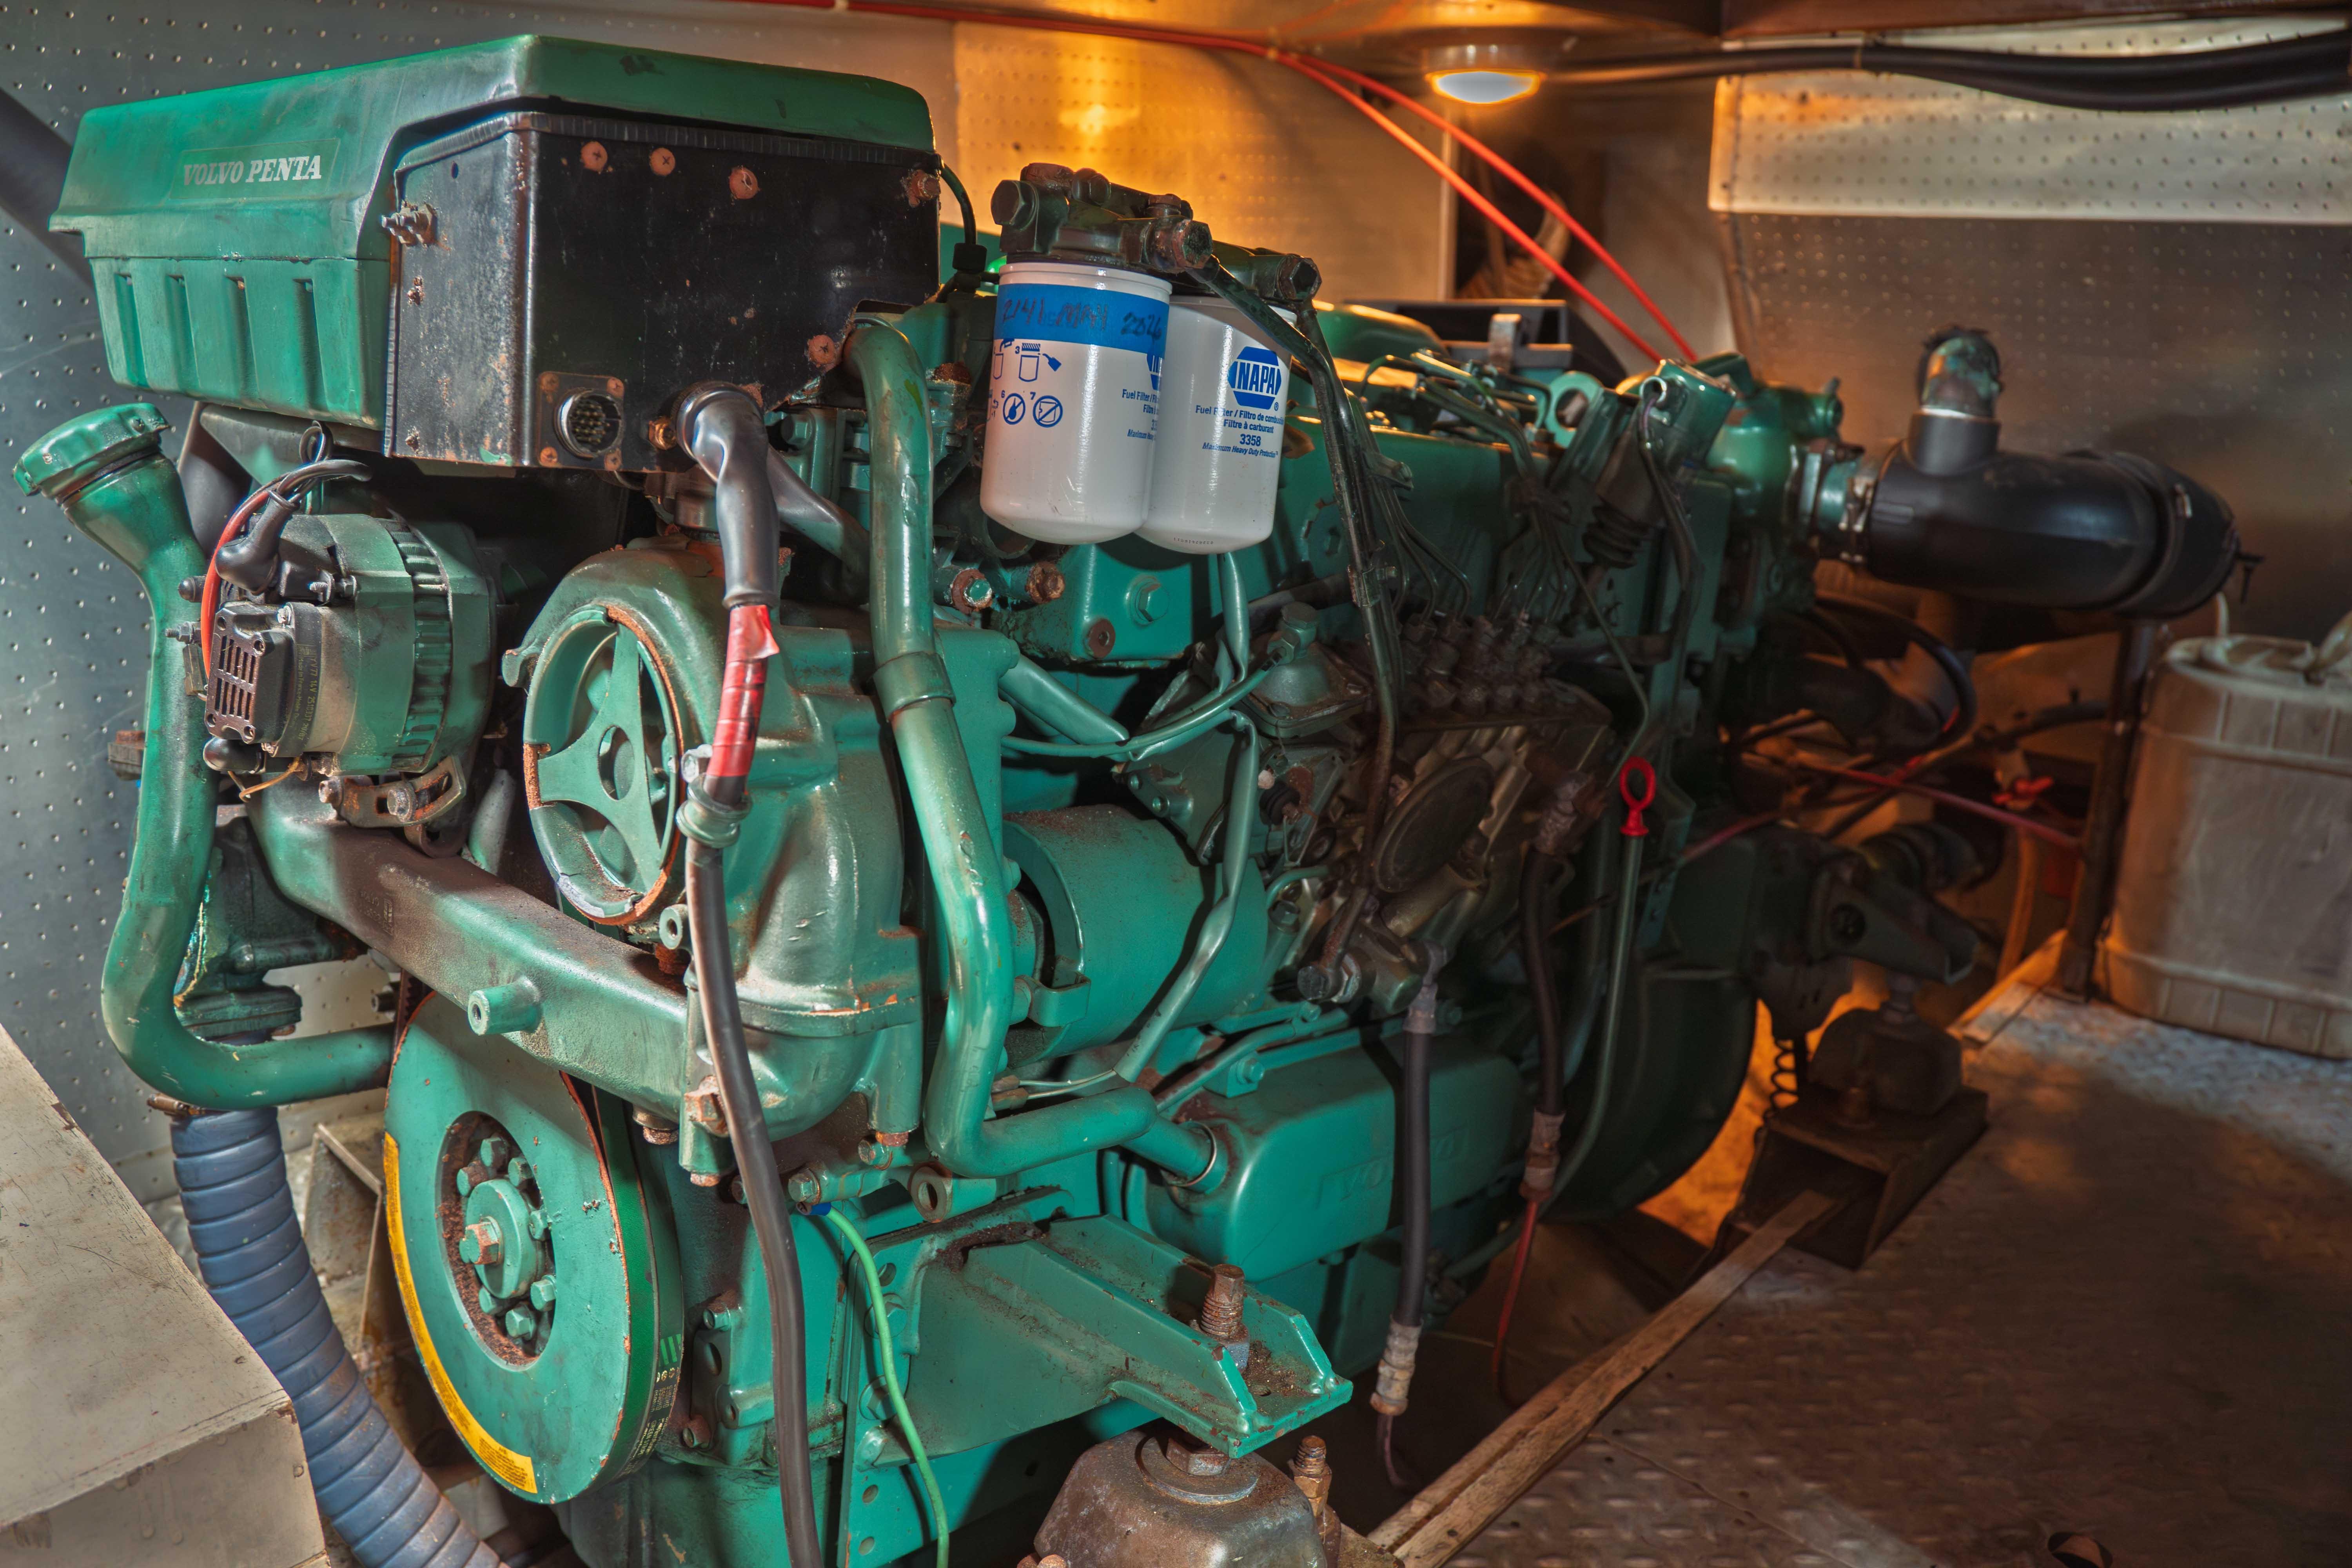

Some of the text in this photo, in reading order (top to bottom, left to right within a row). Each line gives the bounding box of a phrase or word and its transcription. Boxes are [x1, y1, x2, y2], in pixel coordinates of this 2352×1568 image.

[184, 155, 322, 185] VOLVO PENTA
[1055, 302, 1108, 331] MAY
[1237, 362, 1276, 395] NAPA
[1030, 392, 1036, 400] 7
[1122, 388, 1136, 399] Fuel
[1136, 391, 1150, 402] Filter
[1195, 405, 1211, 414] Fuel
[1239, 410, 1256, 420] Filtro
[1258, 413, 1264, 421] de
[1223, 419, 1274, 434] Filtre à carburant
[1240, 434, 1261, 446] 3358
[1232, 446, 1248, 455] Heavy
[1249, 448, 1259, 456] Duty
